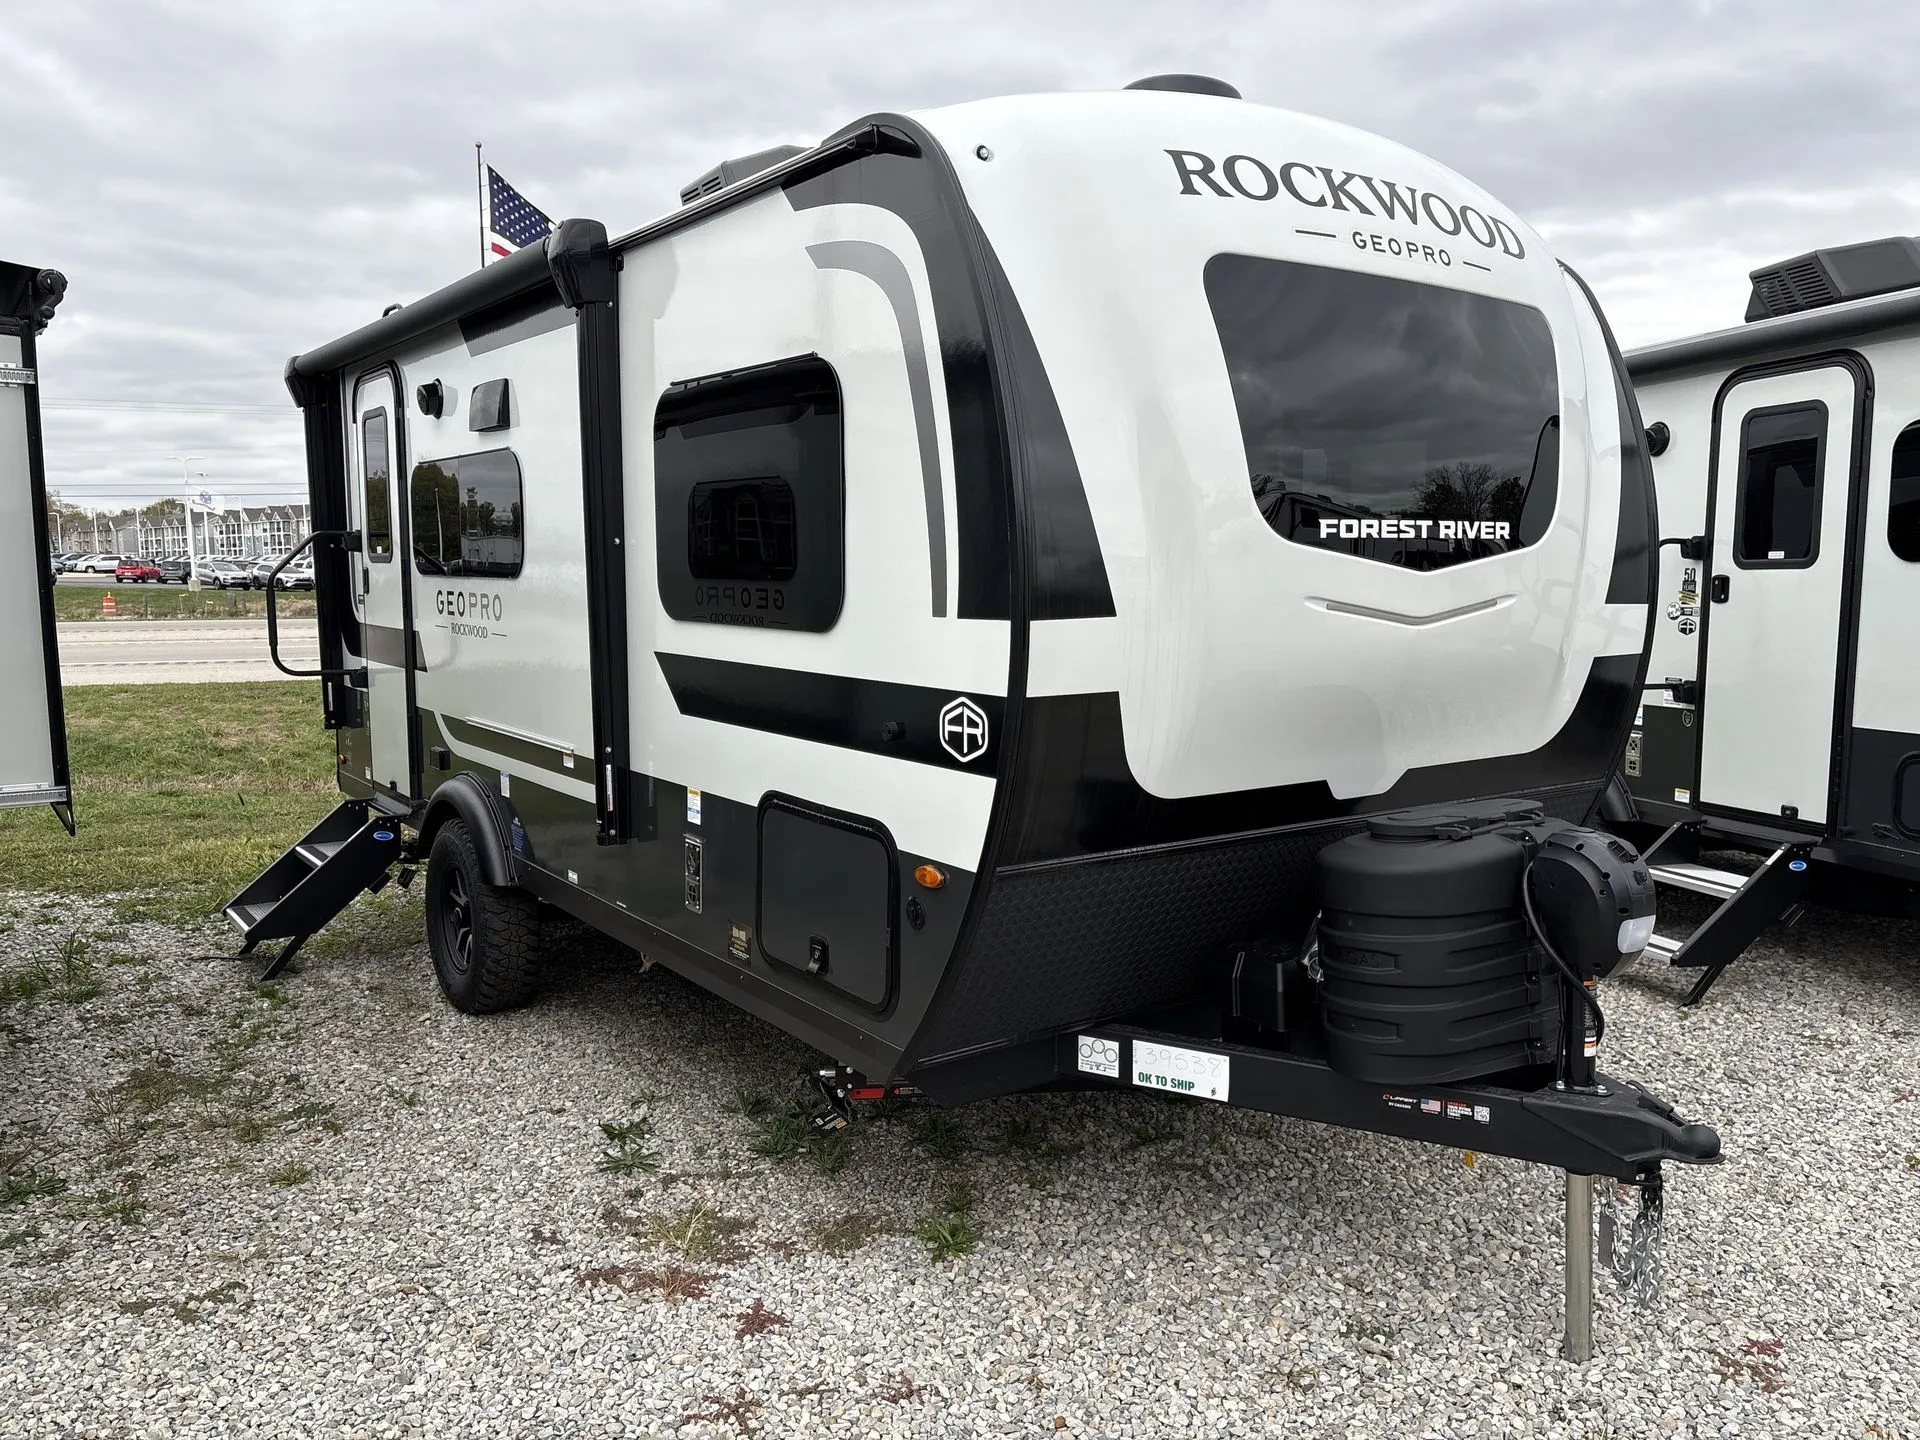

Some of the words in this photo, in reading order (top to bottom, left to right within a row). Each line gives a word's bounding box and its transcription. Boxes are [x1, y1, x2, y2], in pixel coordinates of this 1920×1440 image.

[1163, 148, 1526, 260] ROCKWOOD
[1352, 230, 1452, 267] GEOPRO
[1318, 518, 1433, 539] FOREST
[1438, 520, 1511, 540] RIVER
[436, 589, 503, 622] GEOPRO
[450, 622, 488, 639] ROCKWOOD
[1138, 1071, 1153, 1084] OK
[1155, 1074, 1168, 1087] TO
[1170, 1077, 1195, 1092] SHIP
